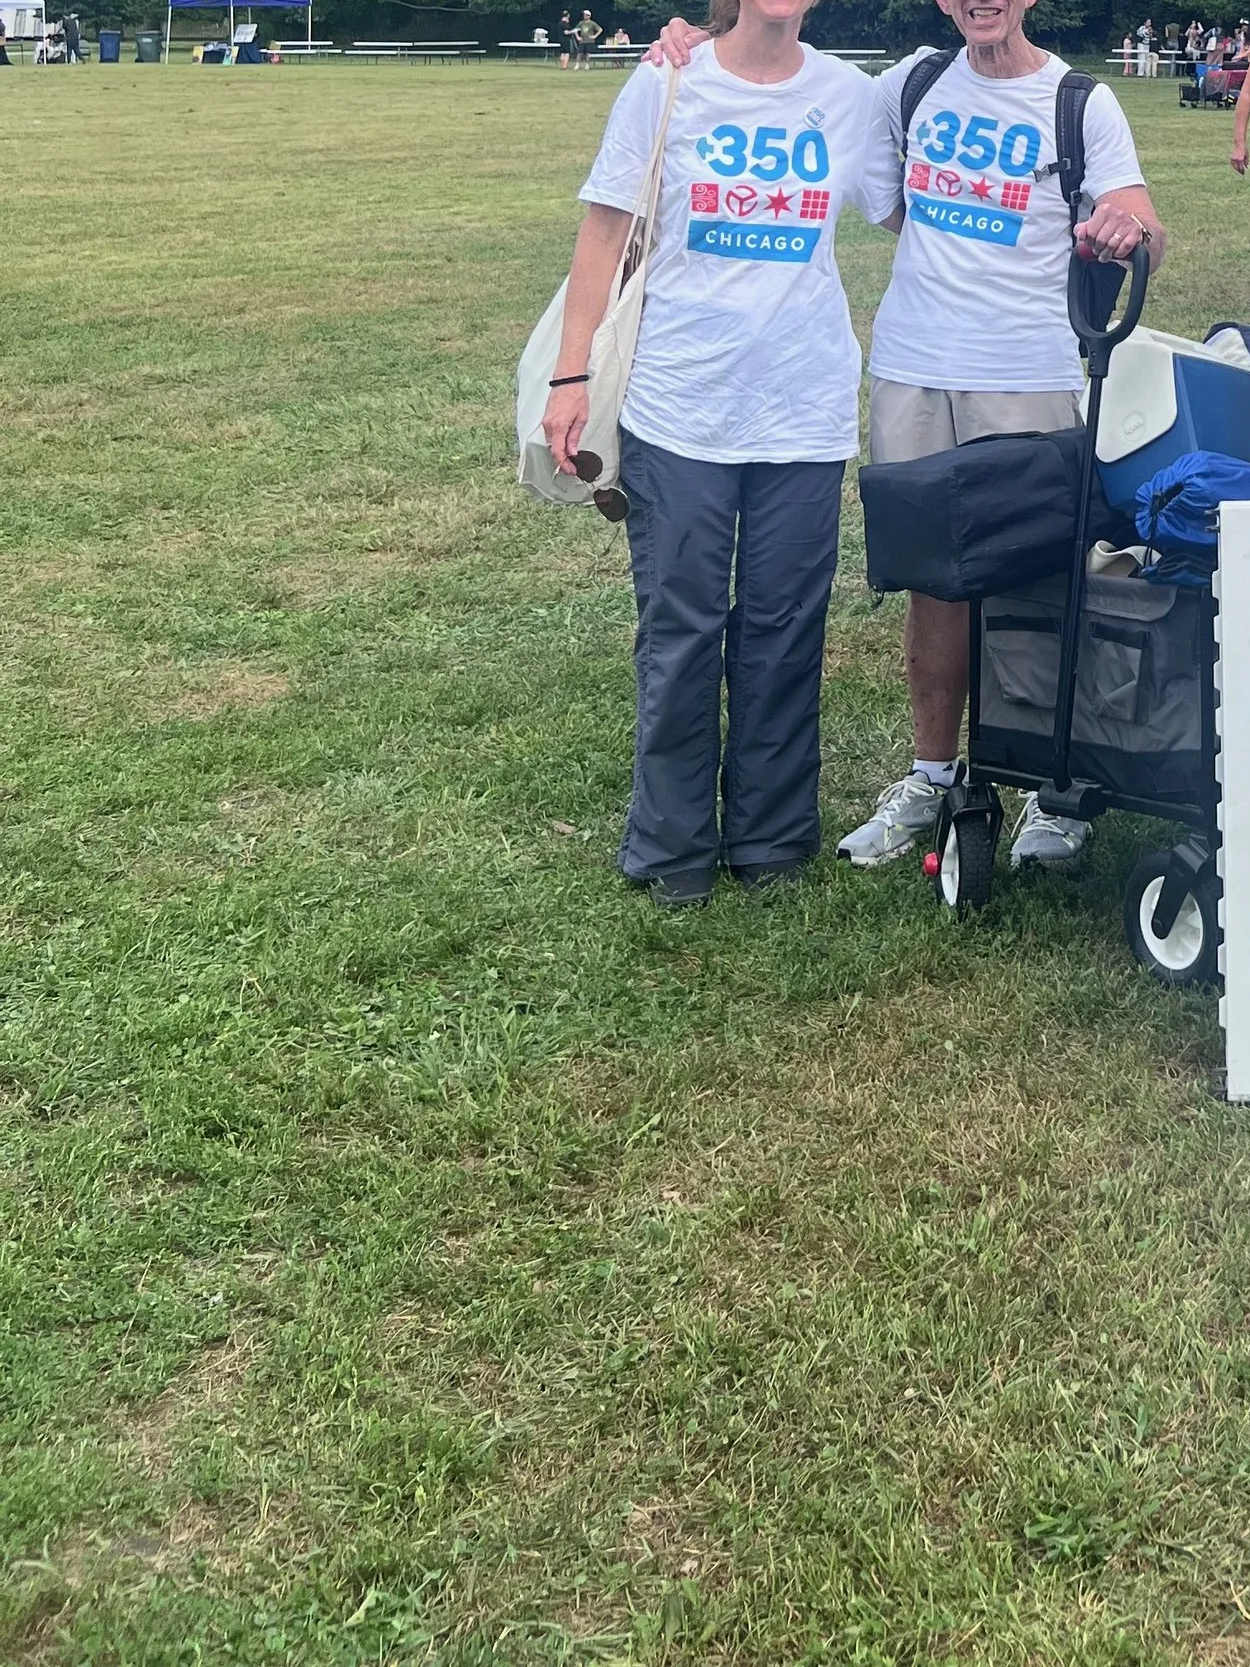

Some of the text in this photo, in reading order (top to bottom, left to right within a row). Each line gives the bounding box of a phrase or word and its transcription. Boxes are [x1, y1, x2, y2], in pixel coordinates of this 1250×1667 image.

[708, 124, 830, 183] 350
[924, 111, 1041, 177] 350
[705, 230, 805, 251] CHICAGO
